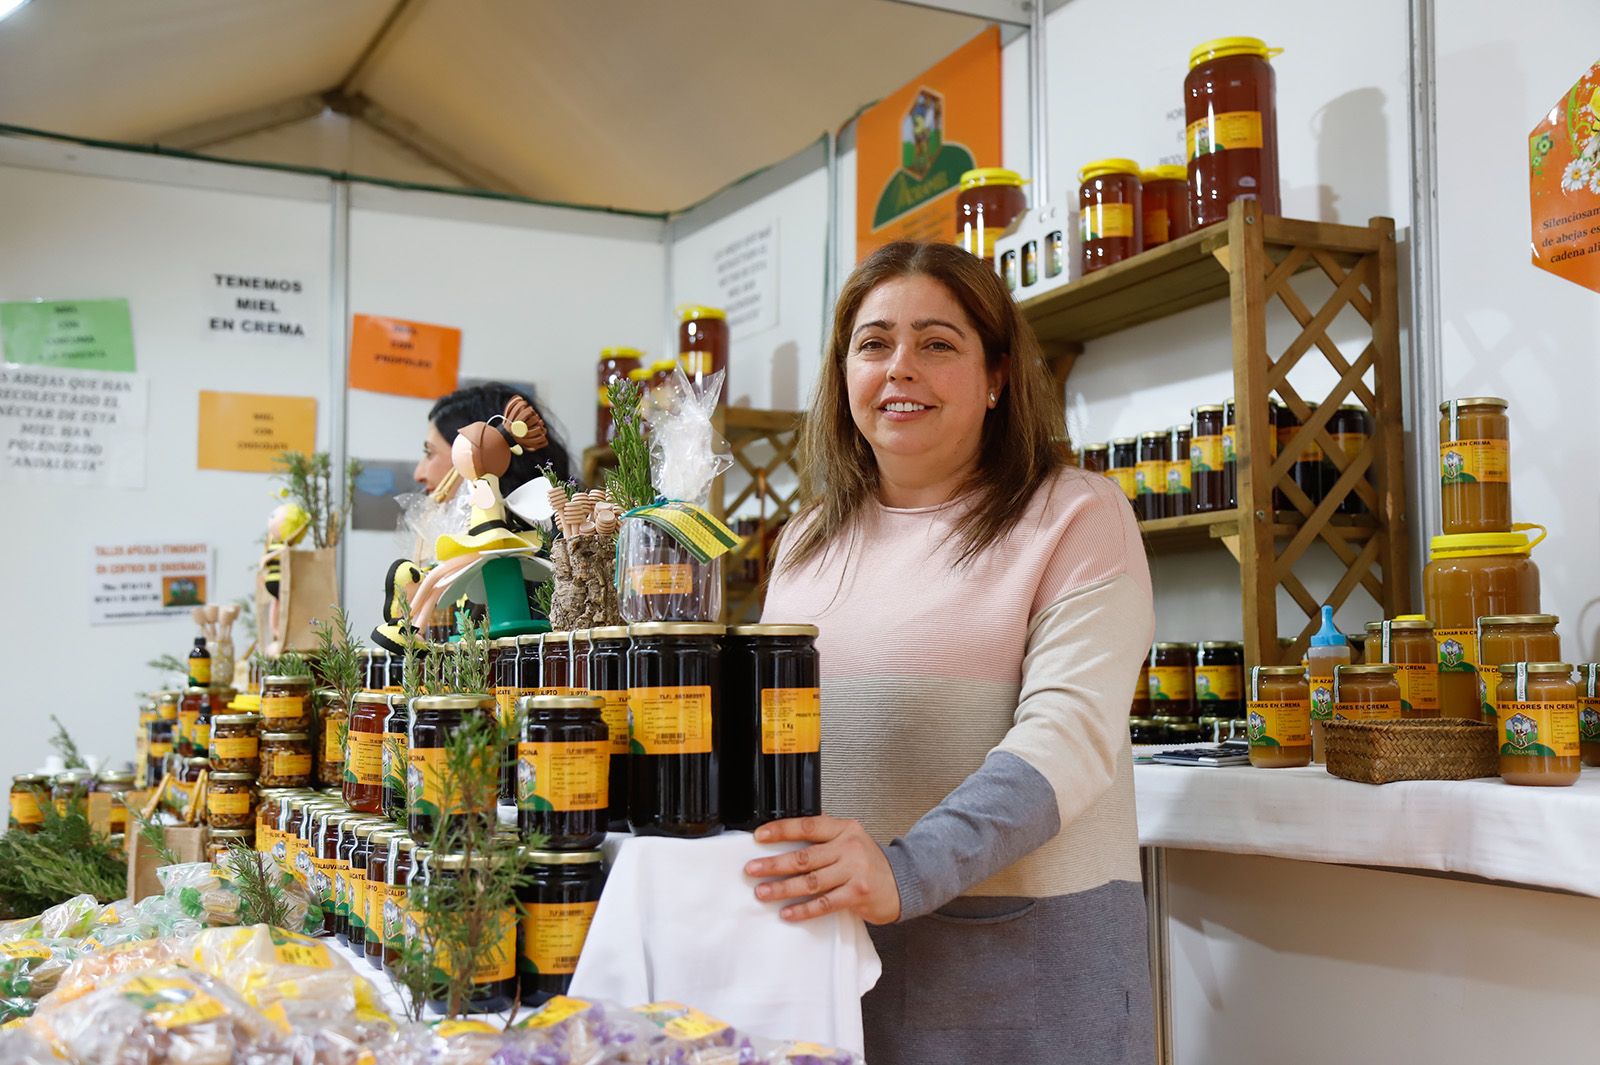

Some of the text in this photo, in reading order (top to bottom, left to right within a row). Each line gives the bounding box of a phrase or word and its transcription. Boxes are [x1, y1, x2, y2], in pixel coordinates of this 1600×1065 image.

[1542, 238, 1553, 247] de
[1556, 229, 1588, 243] abejas
[1550, 248, 1585, 263] cadena
[213, 273, 303, 294] TENEMOS
[236, 298, 280, 313] MIEL
[209, 318, 305, 336] EN CREMA
